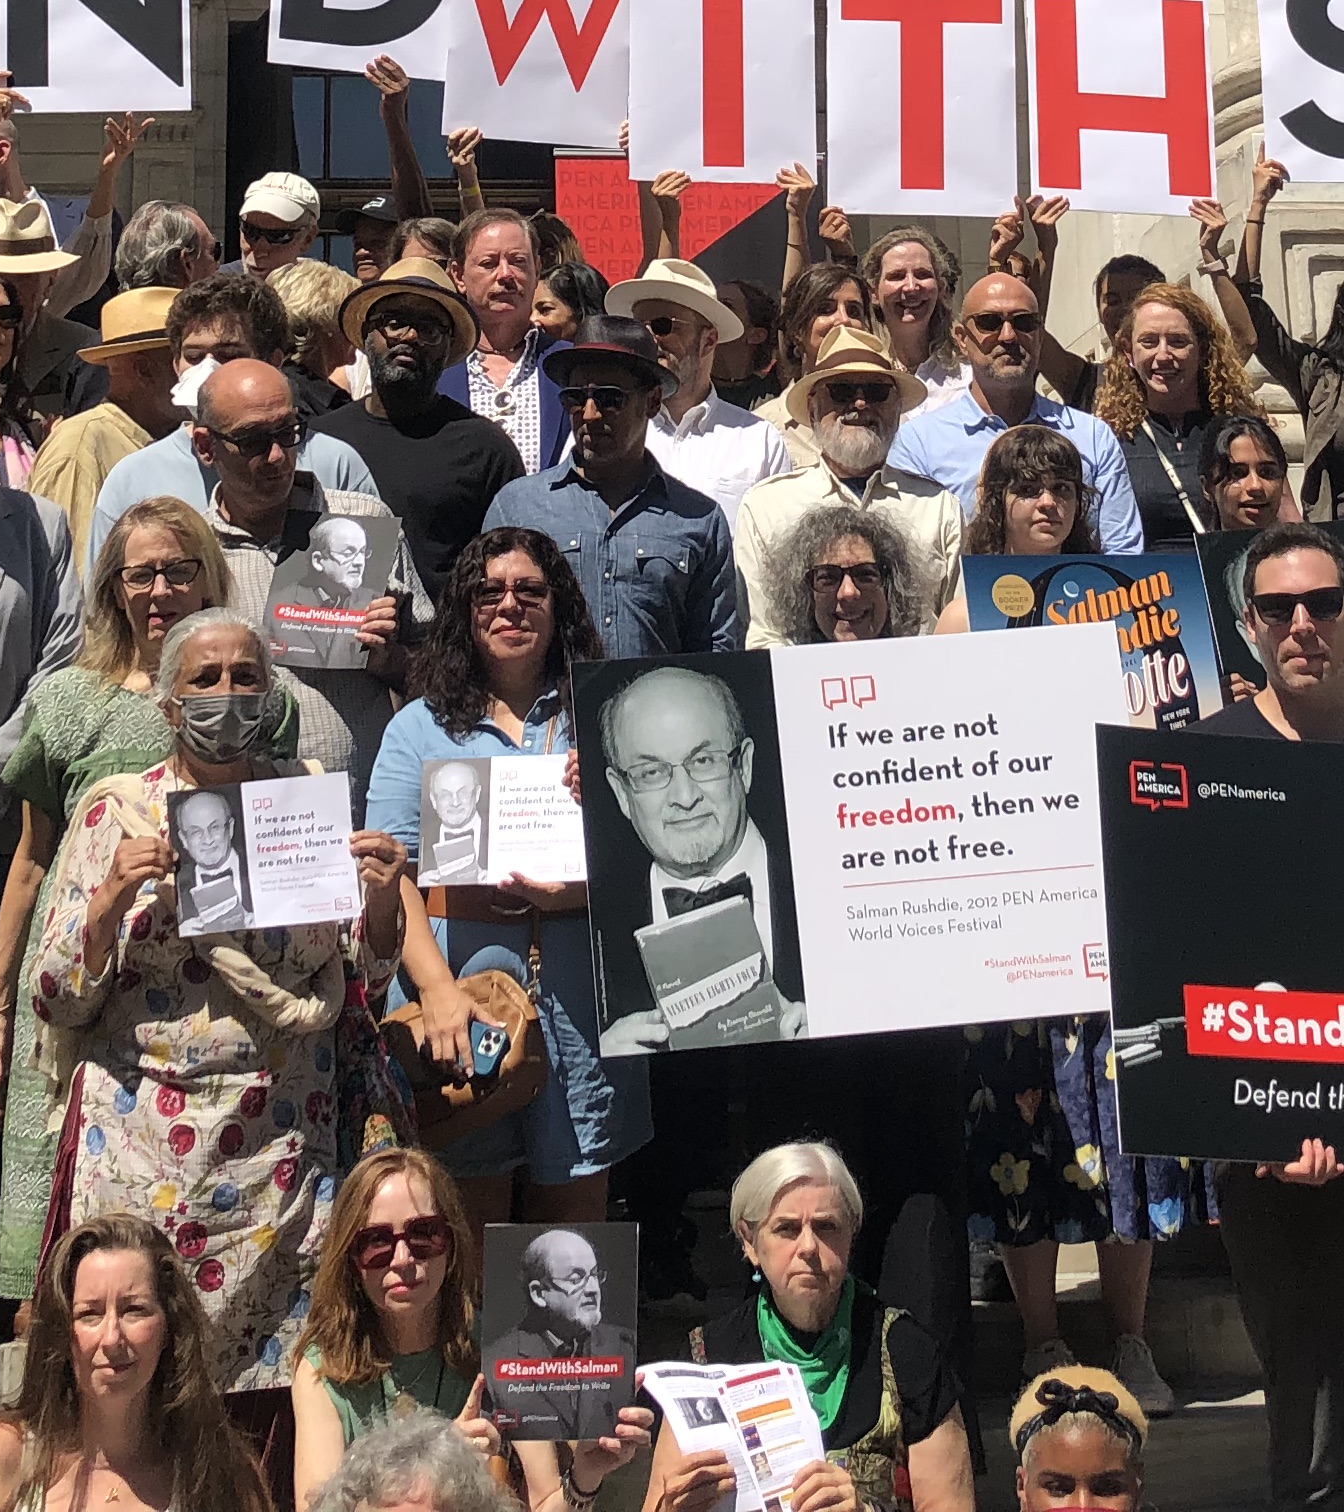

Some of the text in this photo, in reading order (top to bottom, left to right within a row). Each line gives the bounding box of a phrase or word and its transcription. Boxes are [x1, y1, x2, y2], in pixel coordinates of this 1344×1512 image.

[1046, 570, 1174, 626] Salman
[828, 713, 999, 748] If we are not
[832, 750, 1053, 788] confident of our
[1136, 771, 1156, 783] PEN
[1137, 782, 1181, 796] AMERICA
[1197, 782, 1287, 802] @PENamerica
[499, 797, 542, 805] confident
[254, 815, 262, 825] If
[280, 814, 296, 822] are
[298, 810, 315, 821] not
[837, 791, 1080, 829] freedom, then we
[256, 823, 334, 839] confident of our
[256, 841, 302, 853] freedom,
[304, 838, 327, 848] then
[841, 834, 1014, 869] are not free.
[258, 853, 320, 868] are not free.
[846, 886, 1098, 920] Salman Rushdie, 2012 PEN America
[848, 913, 1002, 942] World Voices Festival
[984, 952, 1072, 969] #StandWithSalman
[1006, 966, 1074, 983] @PENamerica
[666, 989, 706, 1017] NINETEEN
[1234, 1079, 1320, 1112] Defend
[500, 1359, 618, 1376] #StandWithSalman
[508, 1383, 535, 1394] Defend
[536, 1383, 547, 1392] the
[549, 1383, 580, 1392] Freedom
[591, 1381, 611, 1390] Write
